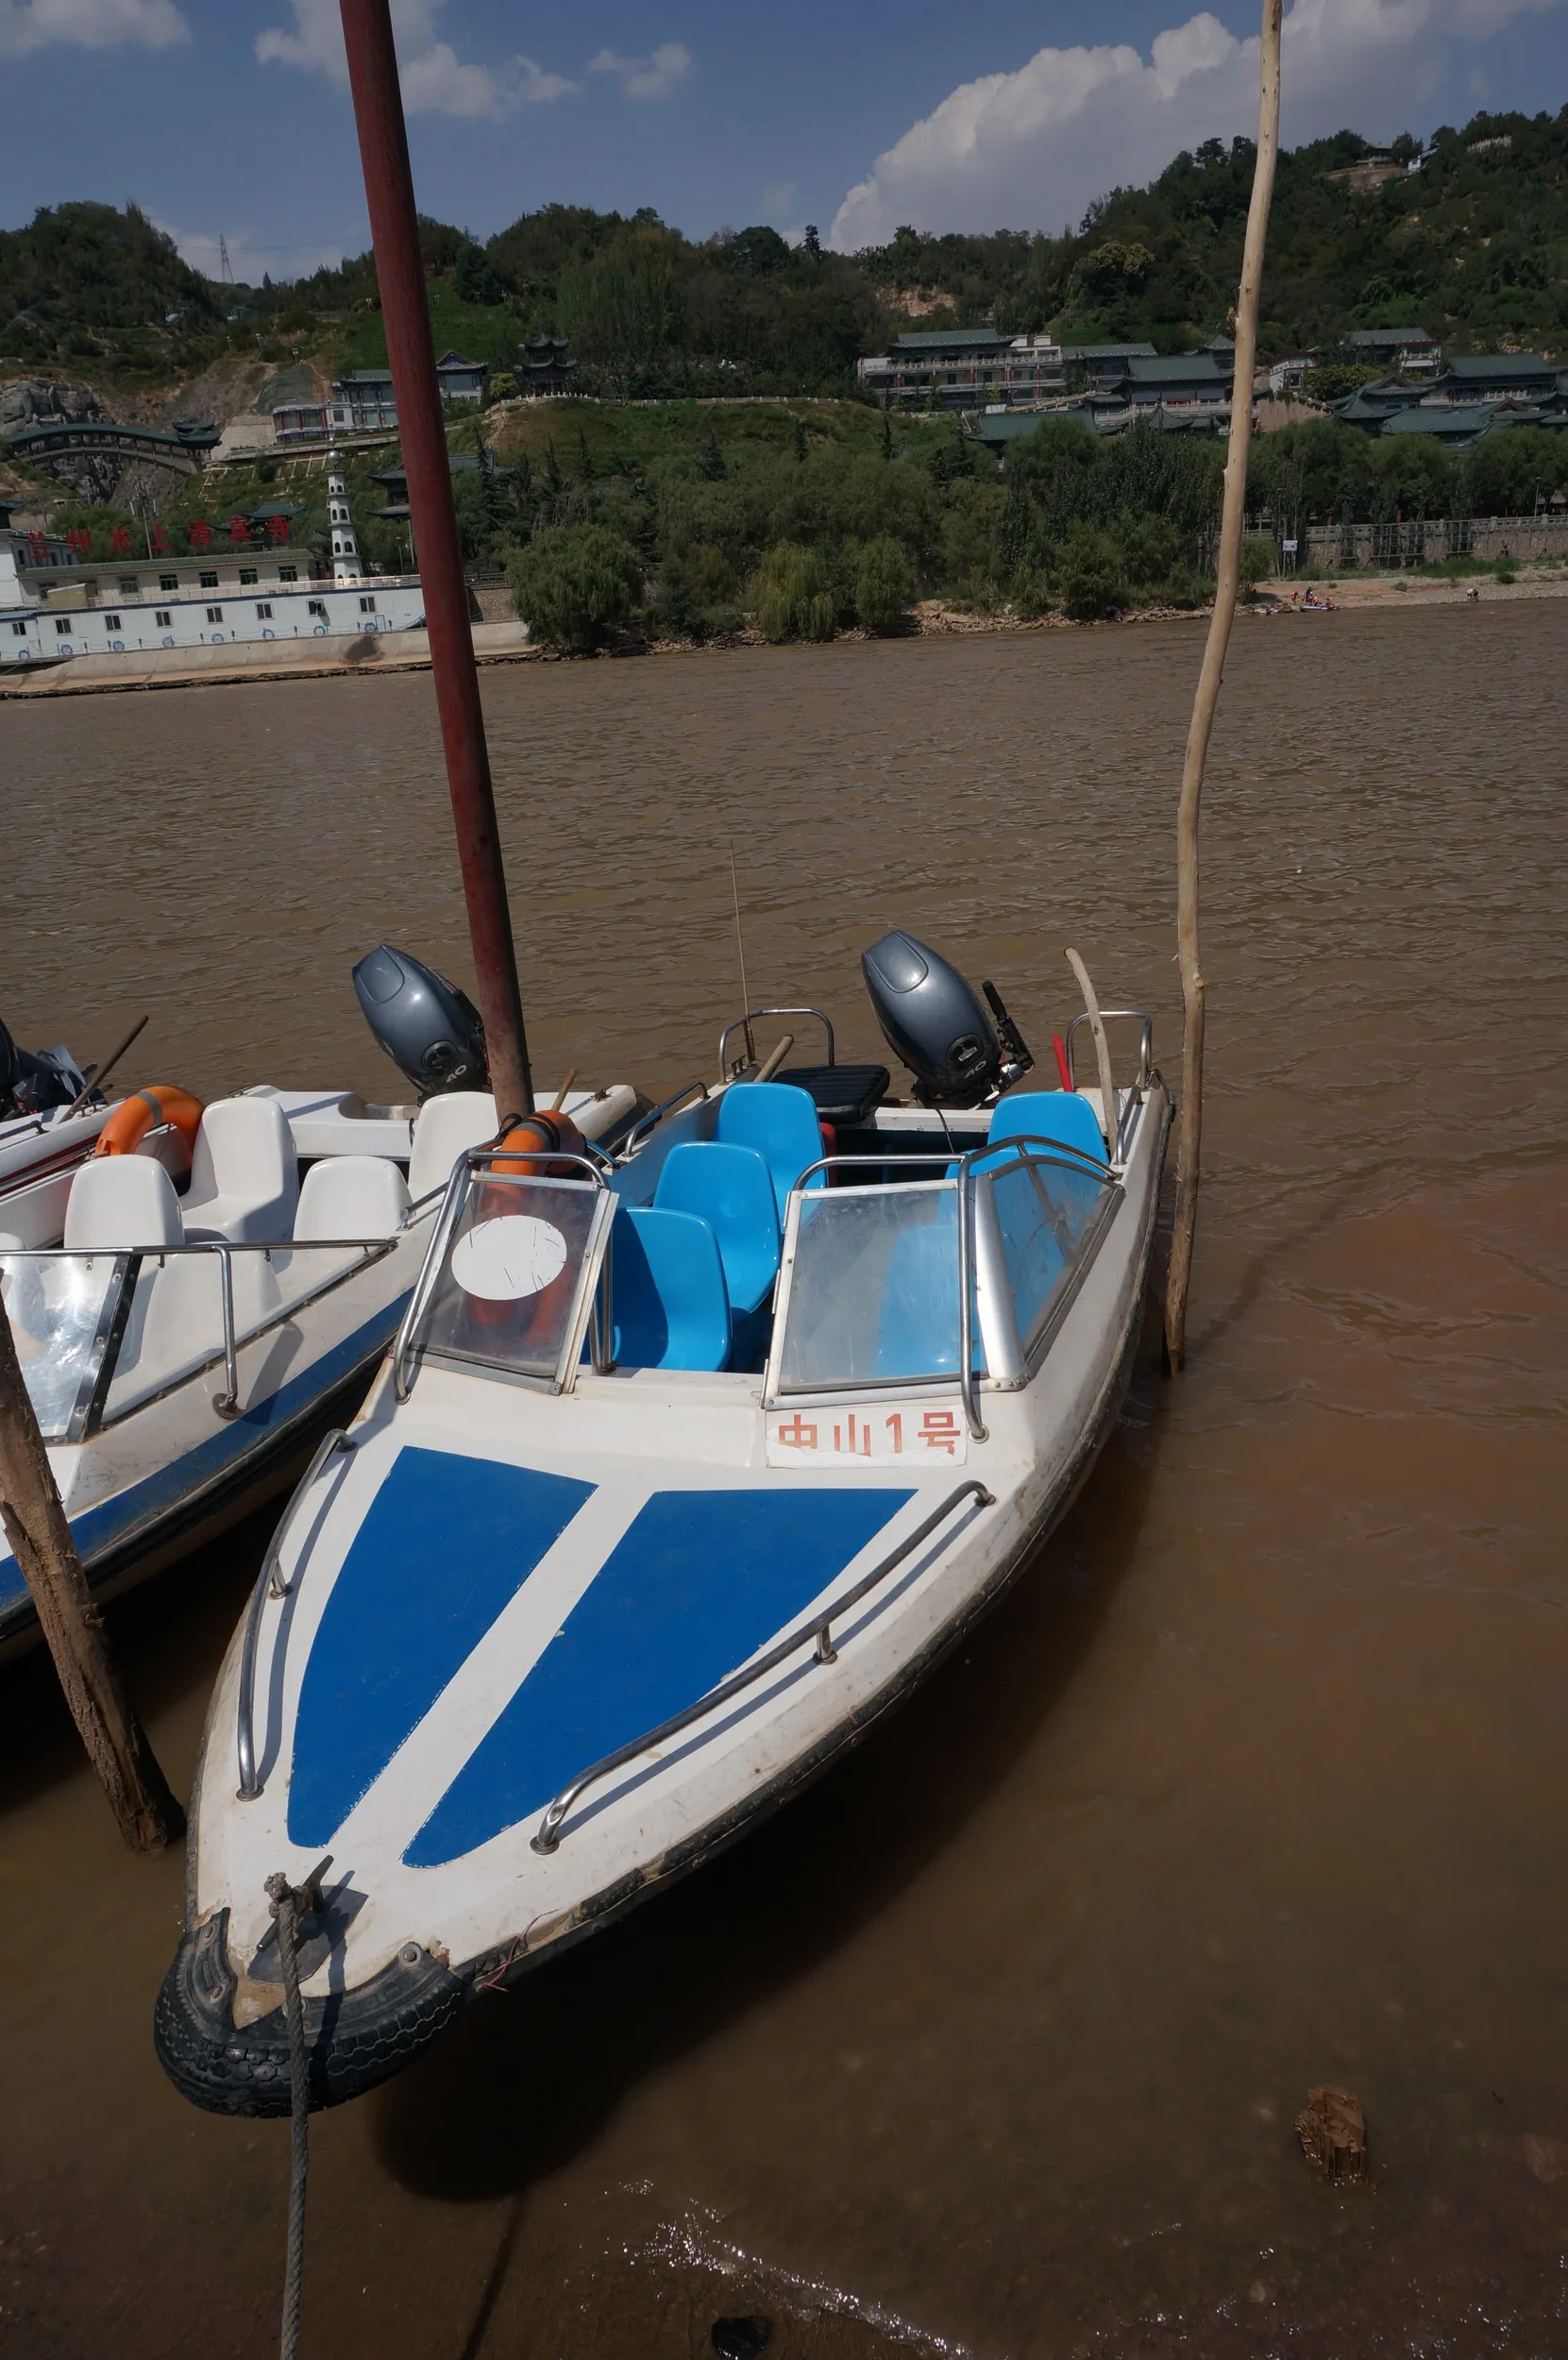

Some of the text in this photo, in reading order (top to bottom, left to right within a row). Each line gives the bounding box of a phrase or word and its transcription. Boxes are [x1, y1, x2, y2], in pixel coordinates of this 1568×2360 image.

[27, 514, 290, 559] 兰州水上清真寺
[446, 1065, 467, 1083] 40
[964, 1060, 987, 1078] 40
